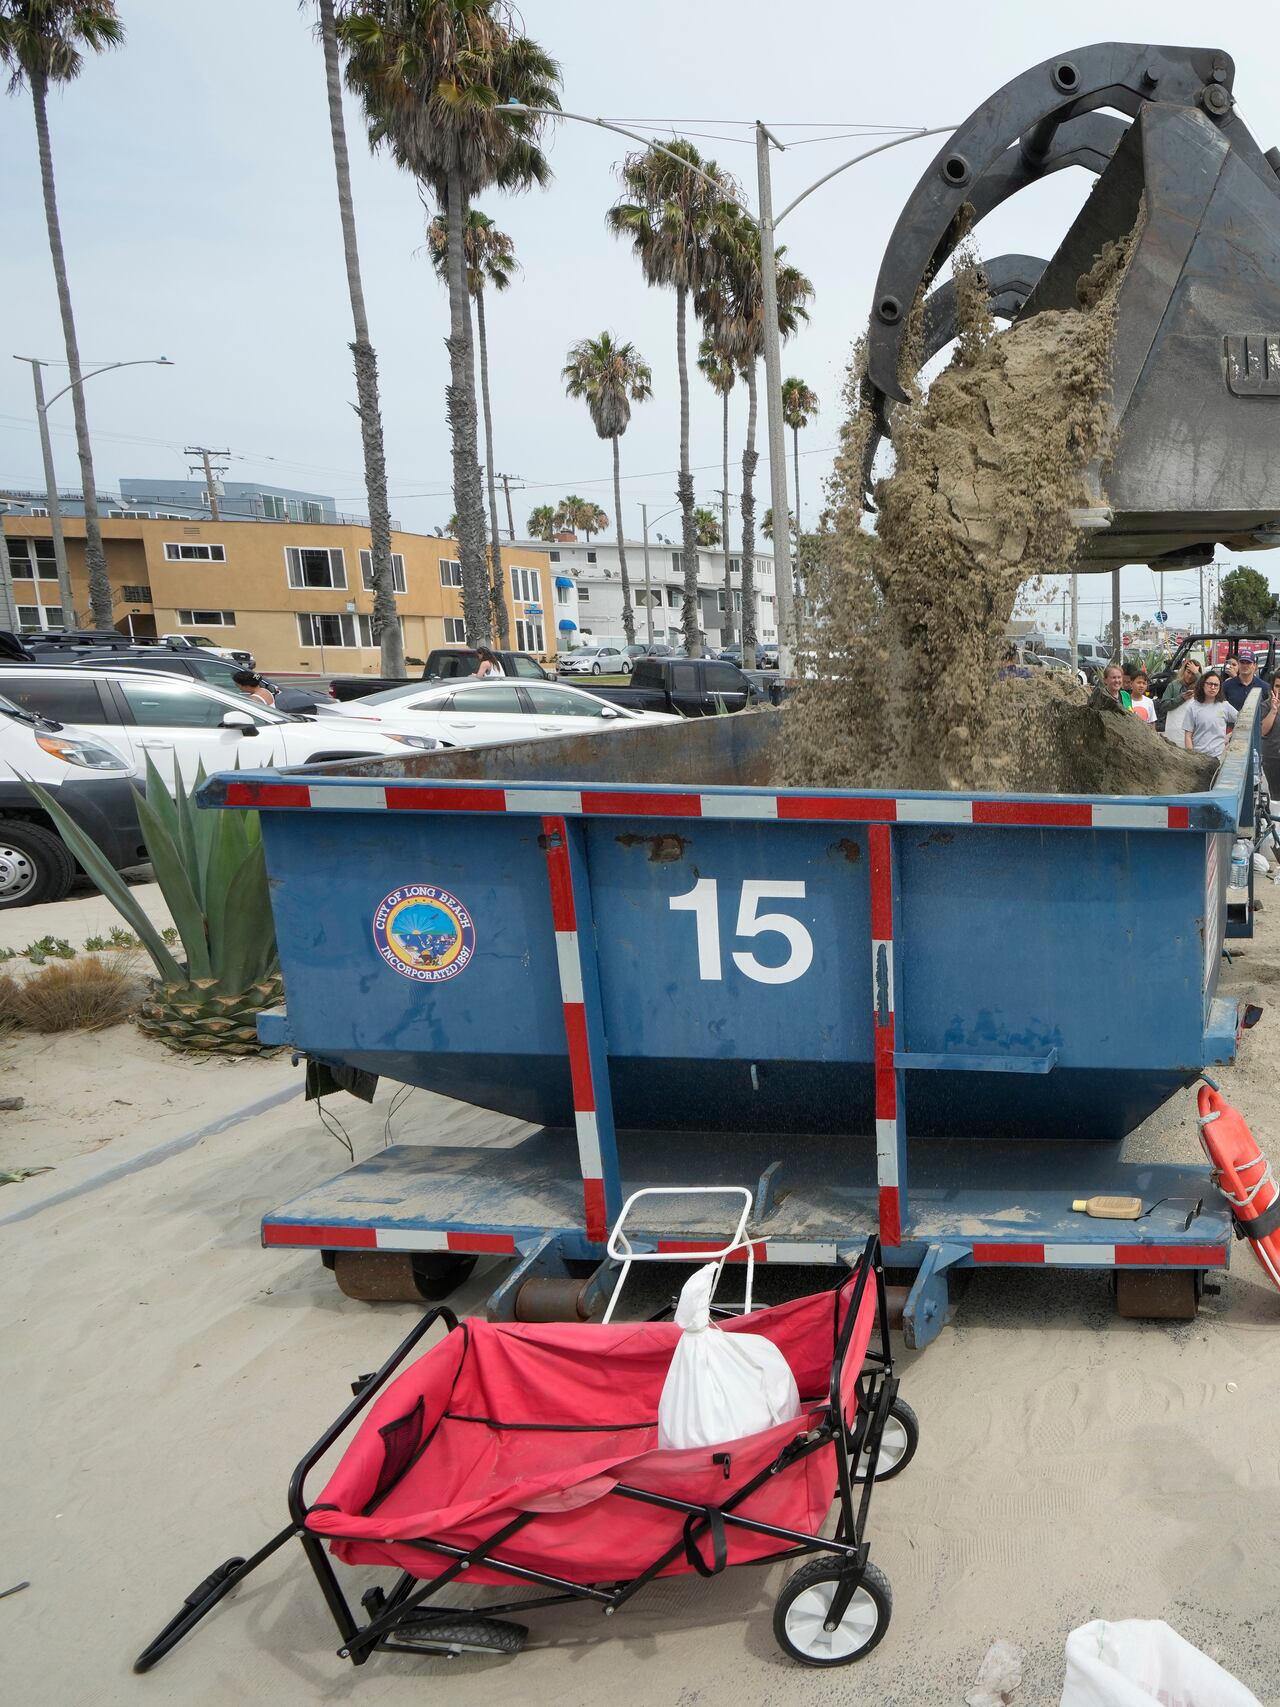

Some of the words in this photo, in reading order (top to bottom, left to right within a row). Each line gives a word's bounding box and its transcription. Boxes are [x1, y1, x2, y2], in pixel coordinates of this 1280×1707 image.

[376, 904, 390, 930] CITY
[388, 892, 402, 905] OF
[404, 886, 436, 897] LONG
[439, 893, 471, 929] BEACH
[669, 878, 814, 985] 15
[381, 945, 458, 980] INCORPORATED
[456, 945, 471, 967] 1897
